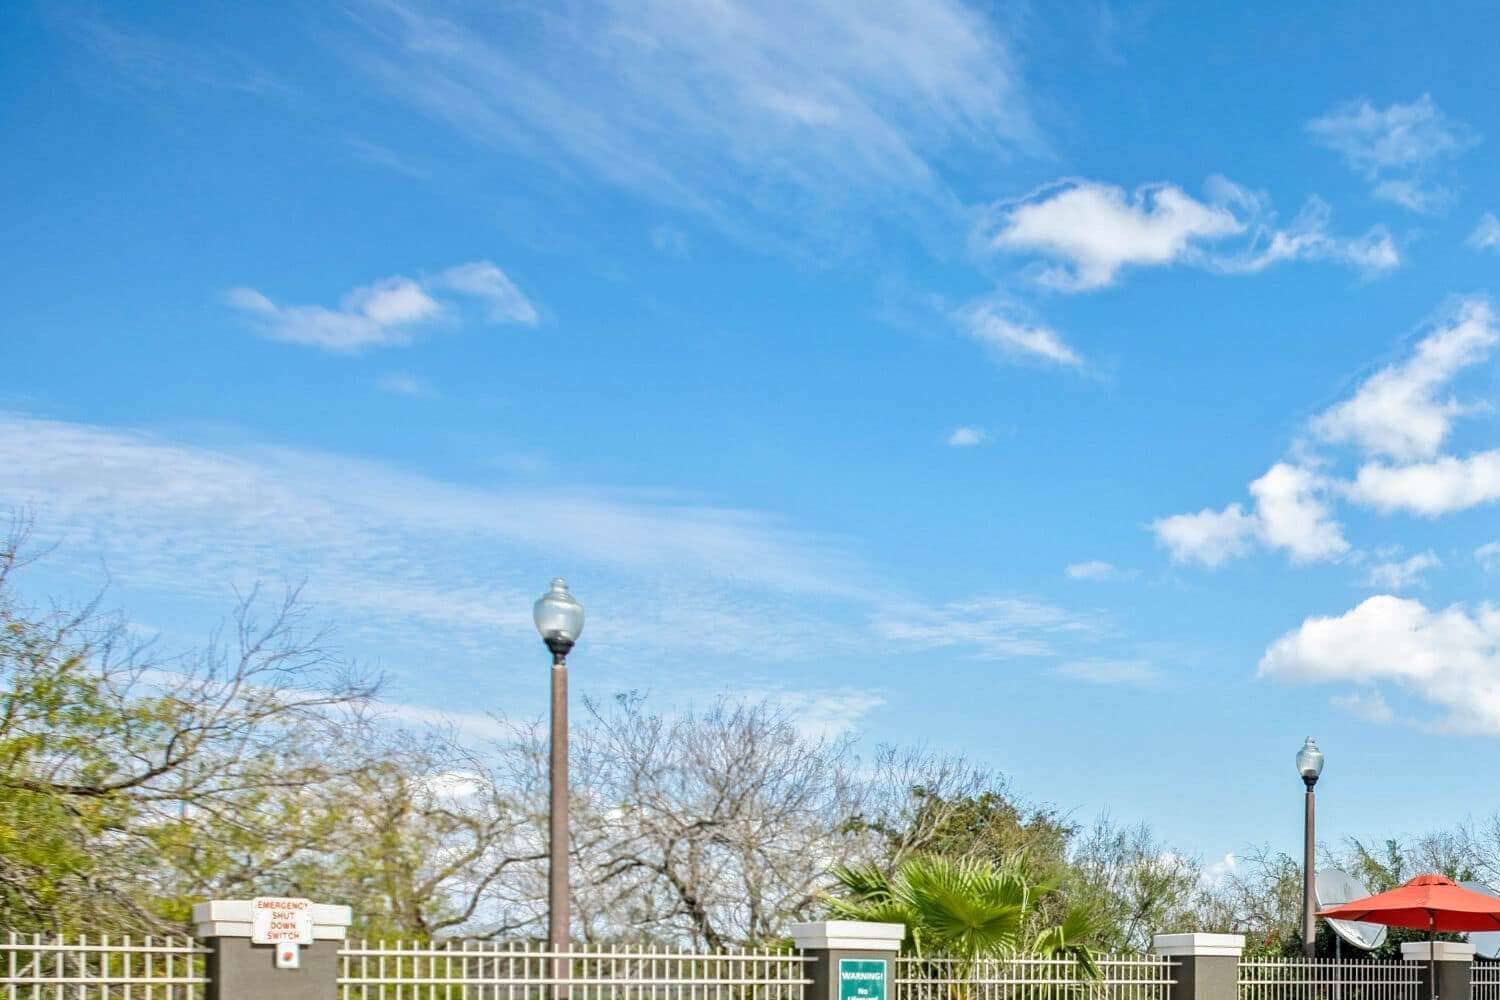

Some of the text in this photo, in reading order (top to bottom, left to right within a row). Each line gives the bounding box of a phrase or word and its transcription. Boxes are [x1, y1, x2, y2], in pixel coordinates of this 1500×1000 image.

[256, 901, 308, 910] EMERGENCY
[272, 911, 295, 920] SHUT
[271, 921, 296, 930] DOWN
[267, 931, 299, 940] SWITCH
[858, 987, 868, 995] No
